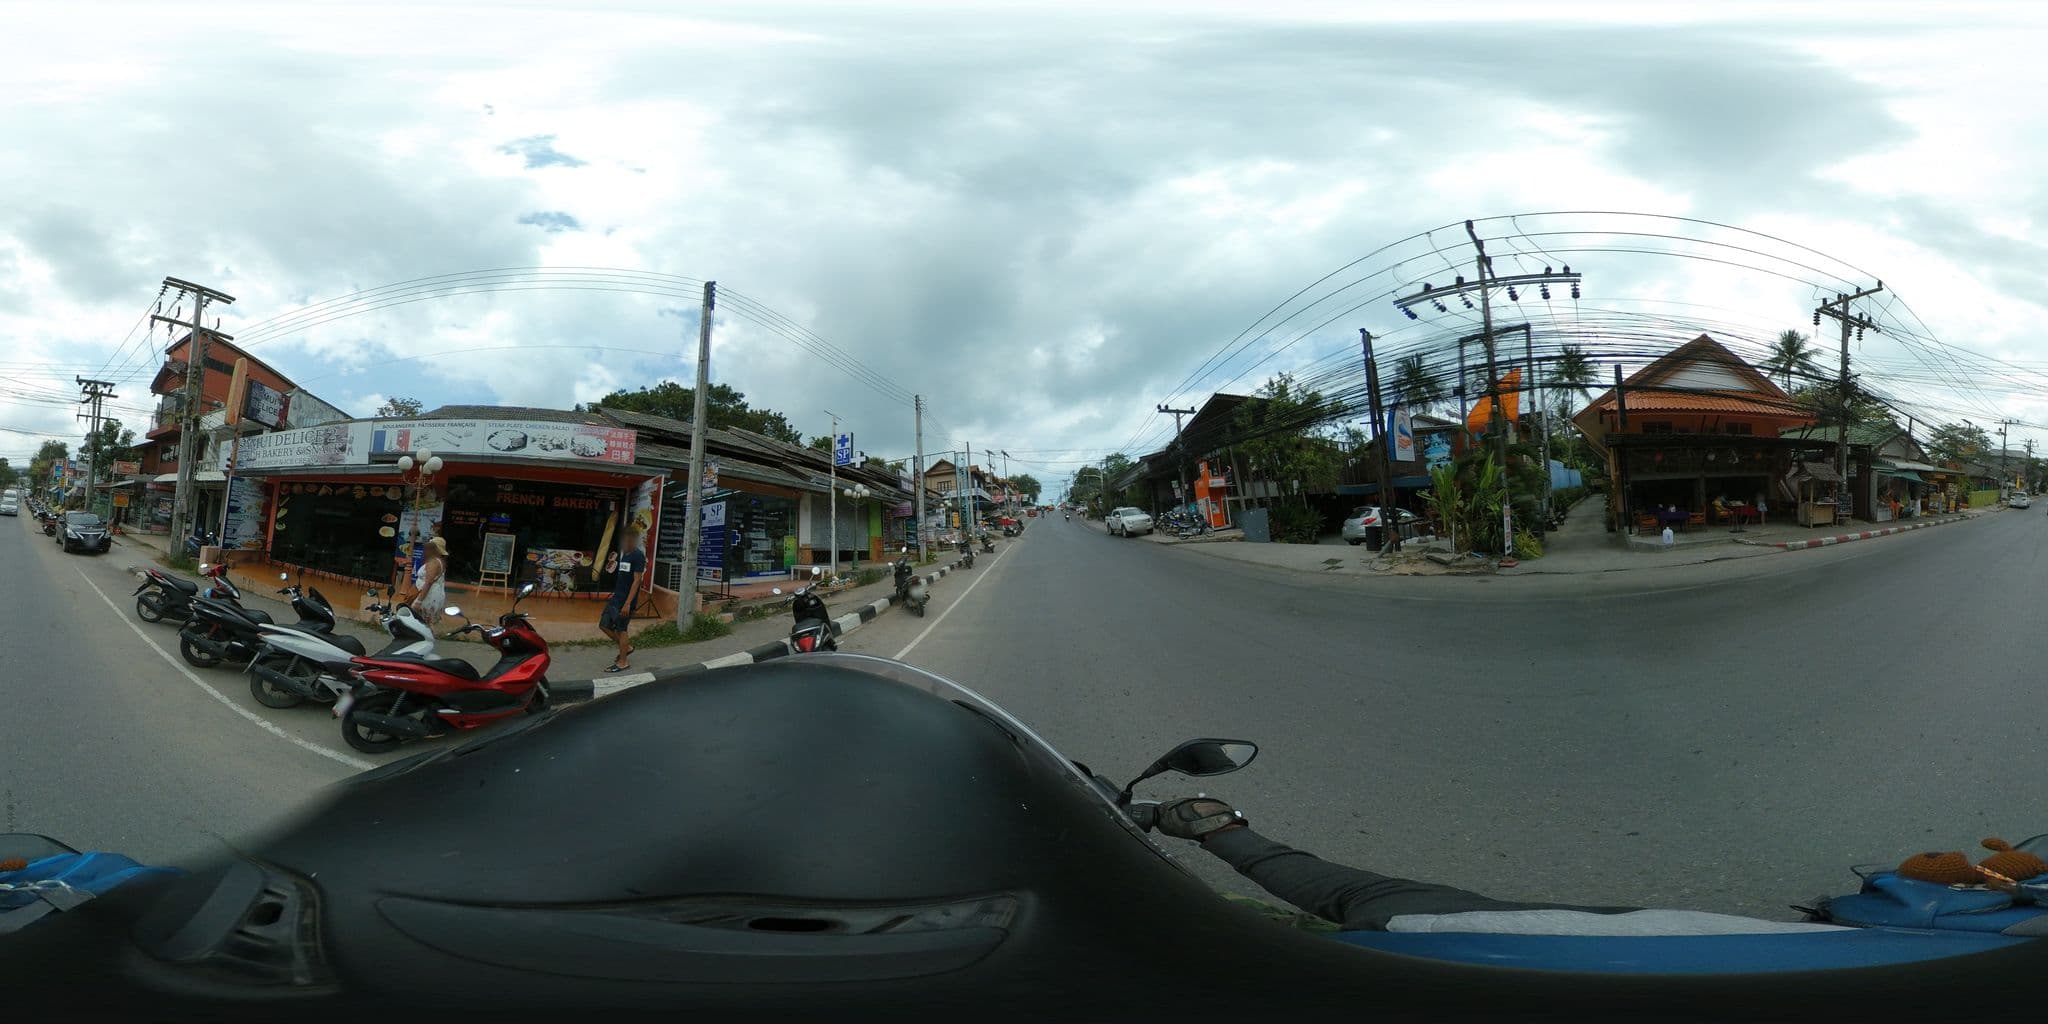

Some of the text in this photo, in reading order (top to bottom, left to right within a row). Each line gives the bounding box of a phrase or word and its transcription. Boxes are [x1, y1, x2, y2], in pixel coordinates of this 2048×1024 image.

[275, 429, 324, 446] DELICE
[262, 447, 294, 458] BAKERY
[837, 449, 849, 459] SP
[496, 492, 601, 510] FRENCH BAKERY
[711, 504, 722, 517] SP
